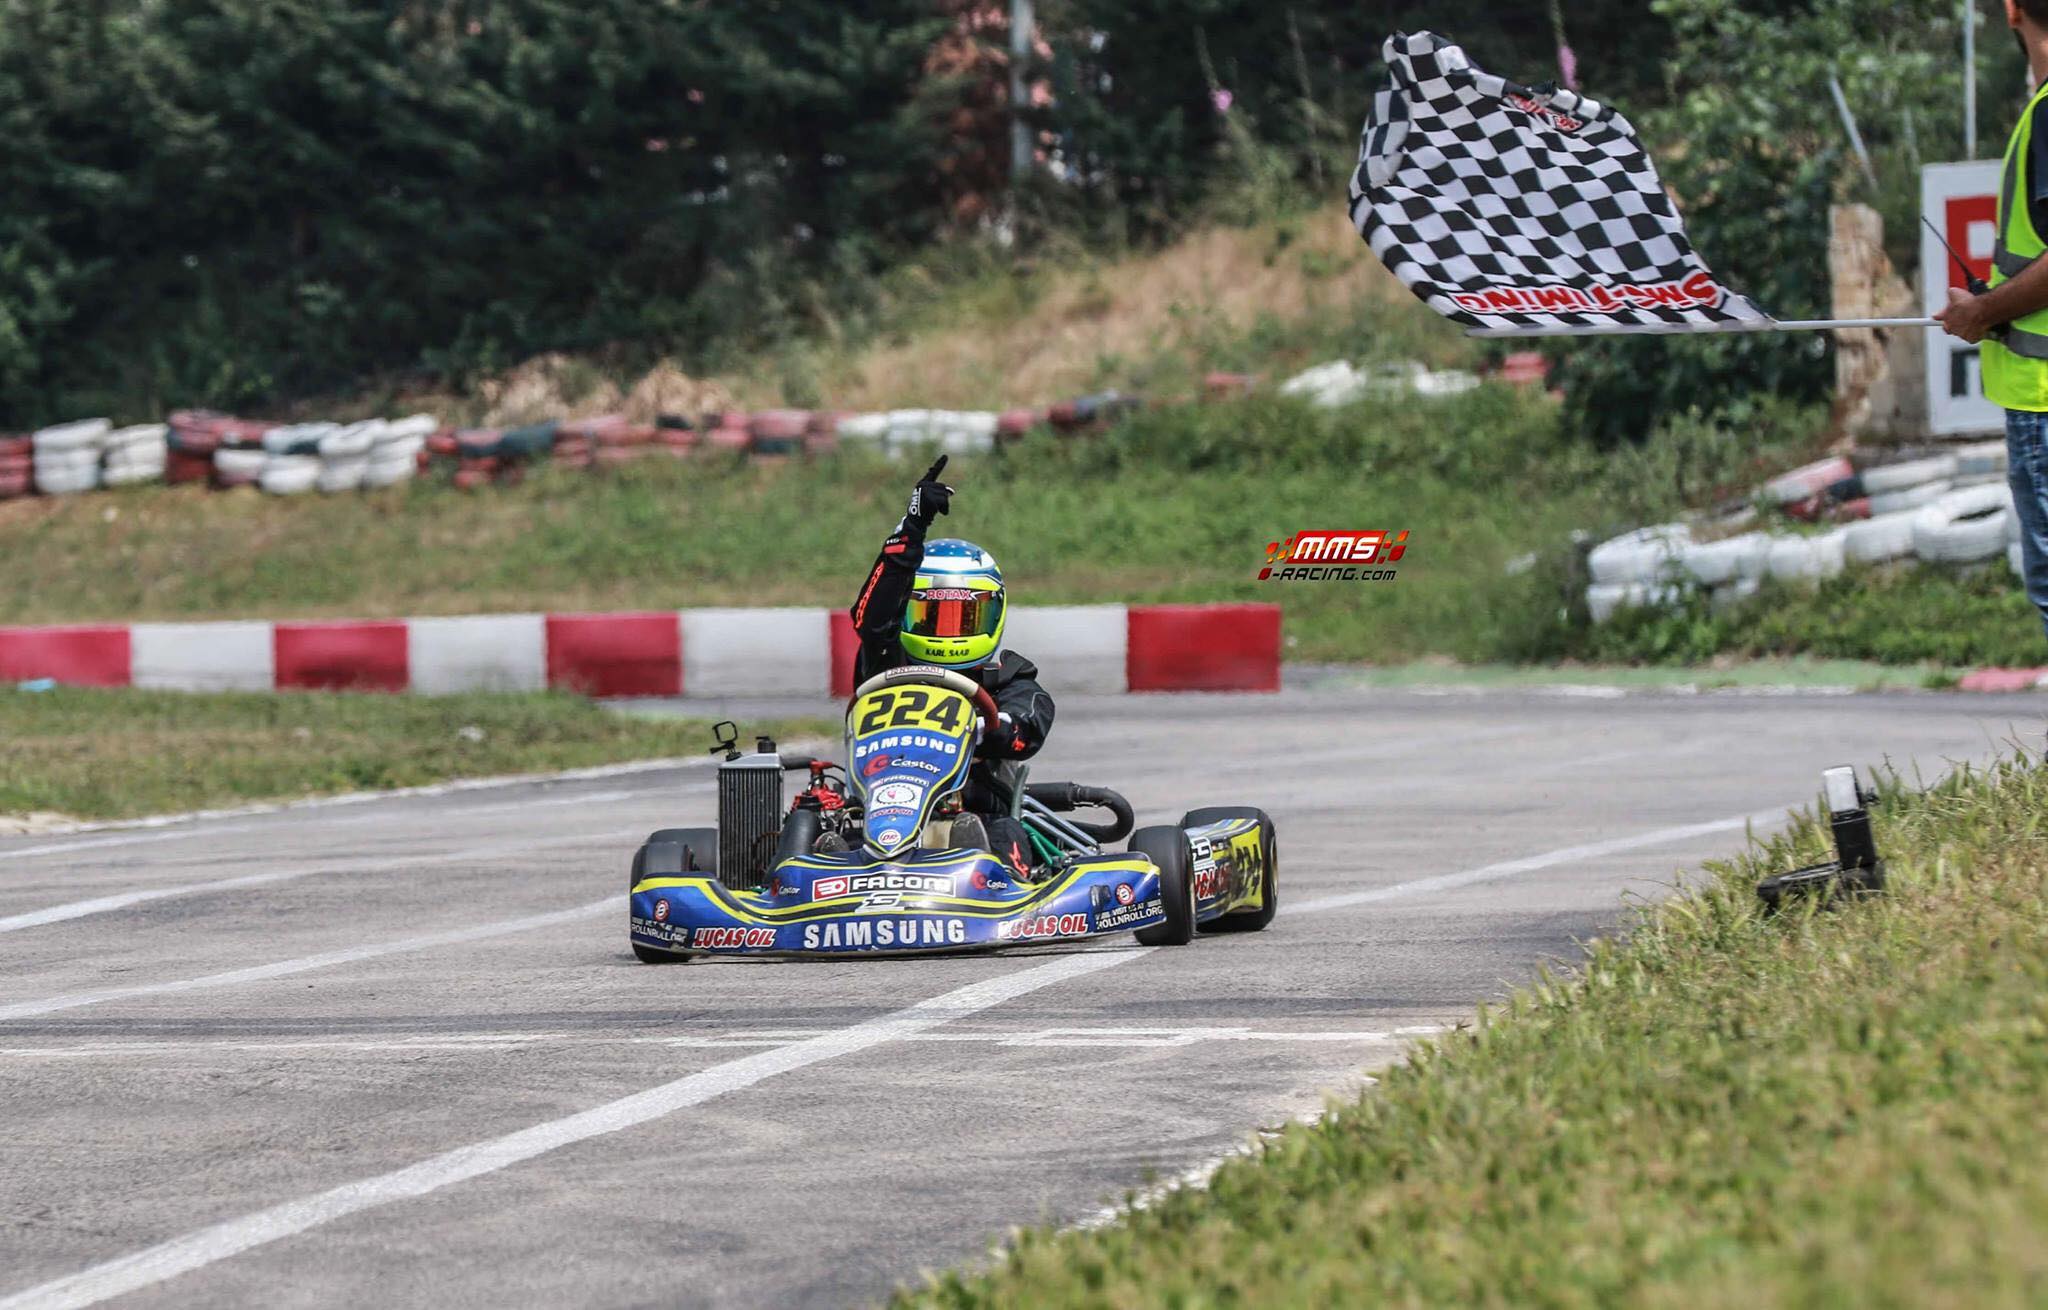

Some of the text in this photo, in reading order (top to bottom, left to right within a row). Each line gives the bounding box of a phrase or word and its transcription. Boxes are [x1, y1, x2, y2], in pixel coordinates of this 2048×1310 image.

[926, 589, 972, 600] ROTAX
[858, 690, 962, 736] 224
[856, 735, 957, 758] SAMSUNG
[852, 875, 949, 893] FACOM
[803, 919, 965, 949] SAMSUNG
[1059, 913, 1088, 935] OIL
[692, 927, 777, 948] LUCAS OIL
